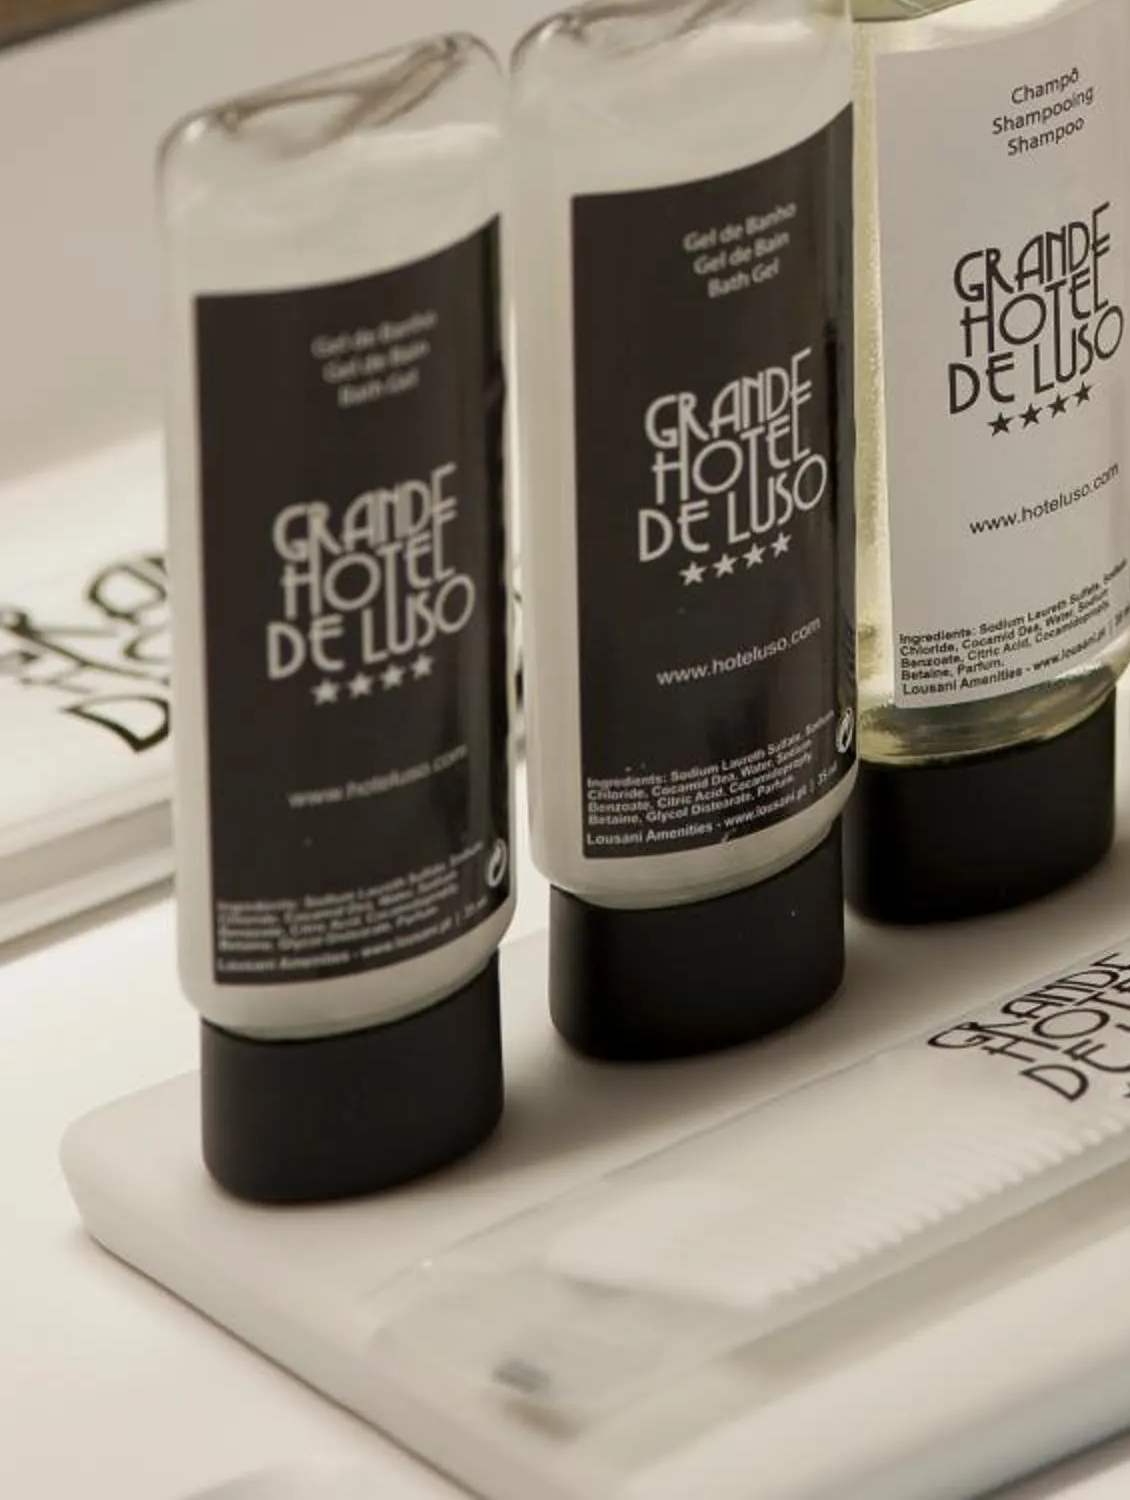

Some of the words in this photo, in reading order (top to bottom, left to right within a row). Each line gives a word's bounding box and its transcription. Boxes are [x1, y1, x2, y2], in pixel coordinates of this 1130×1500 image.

[992, 86, 1094, 135] Shampooing
[1011, 66, 1079, 105] Champô
[1007, 116, 1085, 156] Shampoo
[683, 228, 717, 253] Gel
[693, 250, 727, 275] Gel
[953, 200, 1111, 303] GRANDE
[708, 270, 750, 298] Bath
[751, 256, 780, 283] Gel
[959, 267, 1109, 358] HOTEL
[948, 350, 1016, 415] DE
[1033, 304, 1124, 395] LUSO
[645, 348, 812, 449] GRANDE
[651, 415, 811, 506] HOTEL
[272, 461, 458, 563] GRANDE
[638, 499, 711, 563] DE
[728, 453, 827, 545] LUSO
[968, 462, 1120, 535] www.hoteluso.com
[280, 531, 456, 620] HOTEL
[266, 614, 346, 681] DE
[362, 574, 476, 665] LUSO
[656, 615, 823, 687] www.hoteluso.com
[898, 627, 976, 646] Ingredients:
[903, 679, 957, 695] Lousani
[960, 666, 1023, 690] Amenities
[586, 831, 644, 846] Lousani
[645, 821, 714, 844] Amenities
